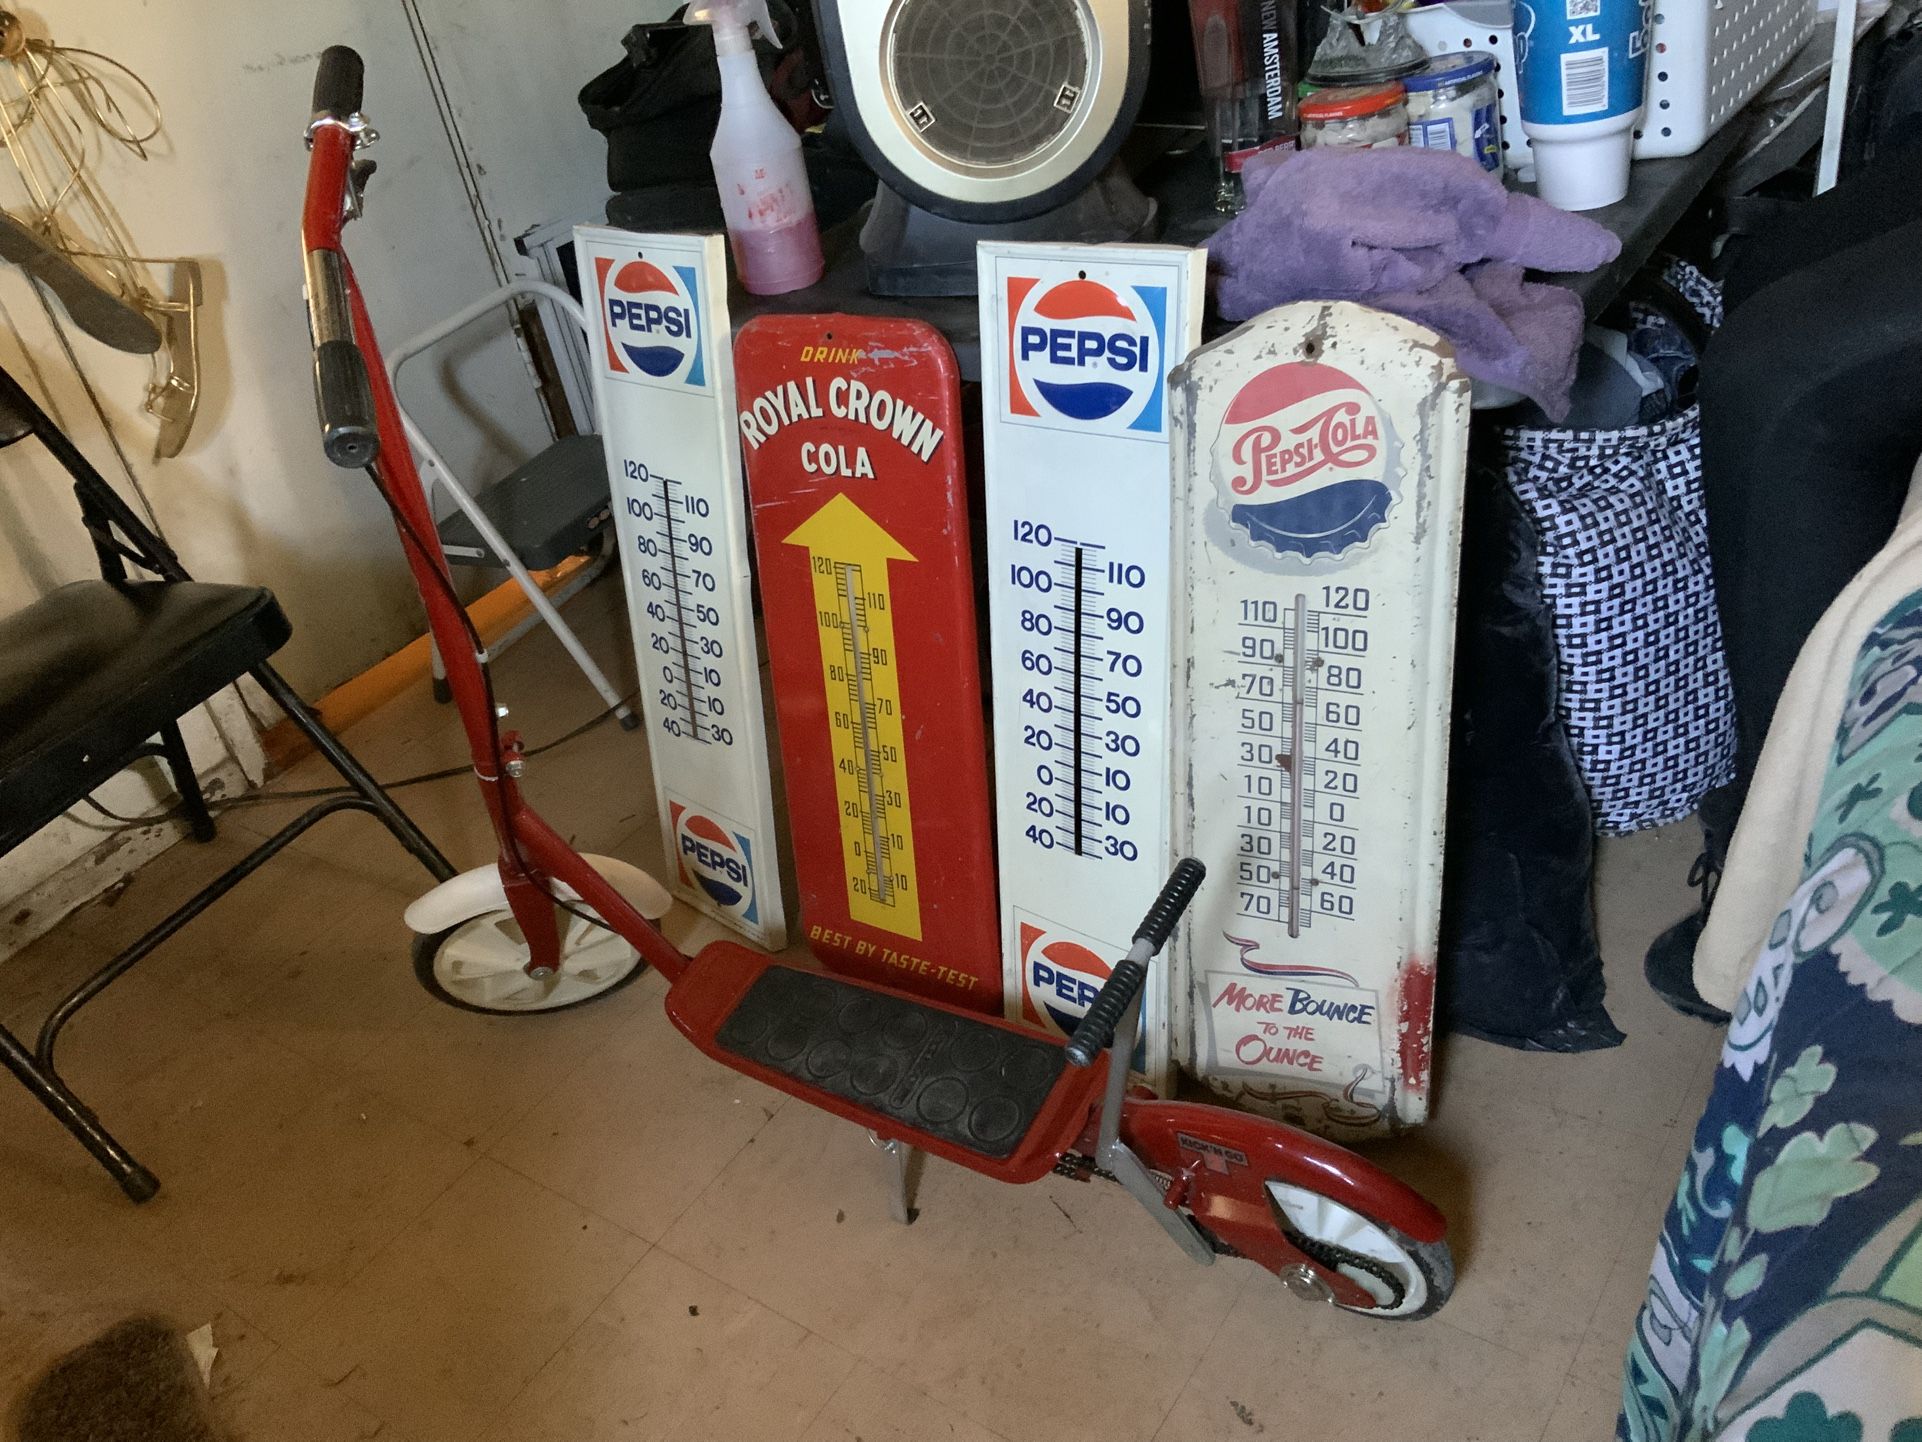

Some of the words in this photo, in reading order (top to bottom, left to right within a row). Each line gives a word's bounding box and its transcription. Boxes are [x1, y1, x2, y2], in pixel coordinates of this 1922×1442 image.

[1568, 23, 1601, 44] XL
[1262, 32, 1283, 120] AMSTERDAM
[608, 298, 692, 339] PEPSI
[800, 346, 861, 364] DRINK
[1020, 325, 1150, 373] PEPSI
[739, 376, 823, 450] ROYAL
[829, 377, 944, 463] CROWN
[624, 459, 649, 482] 120
[801, 442, 875, 479] COLA
[627, 497, 653, 521] 100
[685, 494, 710, 518] 110
[688, 533, 713, 556] 90
[1013, 519, 1053, 547] 120
[637, 535, 657, 557] 80
[812, 556, 832, 575] 120
[1108, 561, 1146, 589] 110
[642, 569, 662, 591] 60
[692, 569, 716, 592] 70
[1011, 564, 1053, 593] 100
[867, 592, 885, 610] 110
[1322, 585, 1370, 612] 120
[647, 601, 666, 623] 40
[696, 603, 719, 627] 50
[819, 611, 839, 628] 100
[1020, 609, 1053, 636] 80
[1106, 607, 1144, 635] 90
[1240, 599, 1278, 623] 110
[651, 632, 669, 655] 20
[700, 636, 723, 659] 30
[1242, 636, 1275, 660] 90
[1321, 626, 1368, 652] 100
[872, 647, 888, 666] 90
[1021, 649, 1053, 676] 60
[1106, 650, 1143, 678] 70
[663, 666, 674, 684] 0
[704, 666, 721, 687] 10
[829, 665, 844, 682] 80
[1241, 673, 1274, 697] 70
[1327, 665, 1362, 689] 80
[659, 689, 678, 711] 20
[707, 695, 725, 716] 10
[877, 698, 893, 716] 70
[1022, 688, 1053, 714] 40
[1105, 691, 1142, 719] 50
[835, 712, 849, 729] 60
[1241, 708, 1274, 732] 50
[1325, 702, 1361, 726] 60
[663, 717, 681, 738] 40
[711, 724, 733, 746] 30
[1023, 725, 1053, 751] 20
[882, 745, 897, 763] 50
[1105, 730, 1141, 758] 30
[1240, 742, 1273, 764] 30
[1325, 737, 1359, 761] 40
[839, 758, 854, 775] 40
[1037, 764, 1054, 786] 0
[1105, 767, 1131, 792] 10
[1244, 774, 1272, 796] 10
[1324, 769, 1358, 793] 20
[844, 800, 859, 818] 20
[886, 790, 901, 808] 30
[1026, 791, 1054, 818] 20
[1105, 801, 1130, 826] 10
[1244, 805, 1272, 827] 10
[1329, 802, 1344, 822] 0
[891, 834, 904, 850] 10
[1025, 824, 1055, 850] 40
[1104, 835, 1138, 862] 30
[1240, 833, 1272, 856] 30
[1322, 832, 1355, 856] 20
[681, 833, 748, 888] PEPSI
[854, 841, 861, 857] 0
[895, 873, 908, 891] 10
[1239, 862, 1271, 884] 50
[1321, 861, 1355, 884] 40
[852, 877, 867, 894] 20
[1240, 892, 1271, 915] 70
[1320, 891, 1353, 915] 60
[809, 925, 852, 949] BEST
[855, 940, 877, 958] BY
[882, 948, 979, 991] TASTE-TEST
[1033, 961, 1101, 1008] PEP
[1212, 982, 1284, 1013] MORE
[1286, 987, 1375, 1025] BOUNCE
[1257, 1021, 1278, 1036] TO
[1283, 1025, 1316, 1042] THE
[1235, 1033, 1324, 1072] OUNCE
